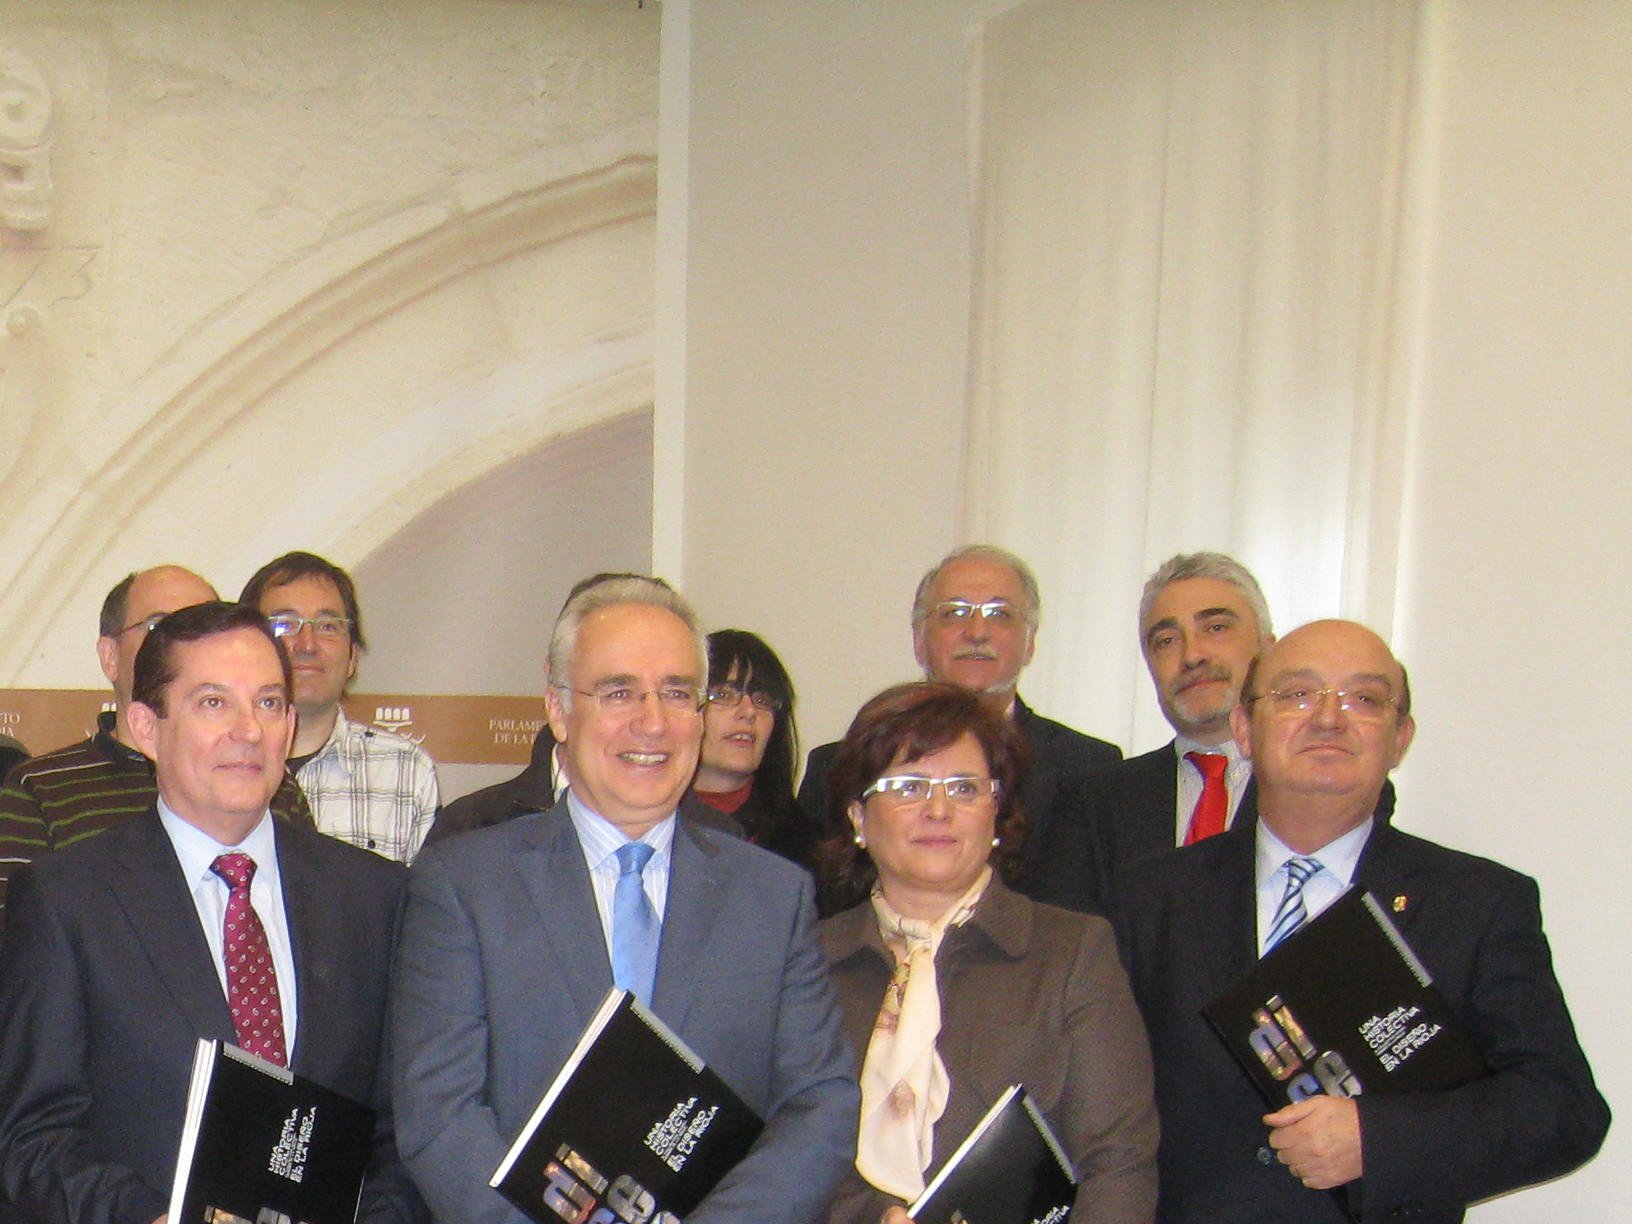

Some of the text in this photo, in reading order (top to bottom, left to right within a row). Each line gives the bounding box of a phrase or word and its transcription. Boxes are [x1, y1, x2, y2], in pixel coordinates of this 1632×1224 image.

[489, 719, 544, 731] PARLAME
[1358, 1015, 1381, 1034] UNA
[1363, 1006, 1407, 1042] HISTORIA
[1369, 1006, 1421, 1049] COLECTIVA
[1379, 1053, 1394, 1065] EL
[1384, 1056, 1401, 1072] EN
[1399, 1047, 1414, 1061] LA
[1412, 1024, 1442, 1049] RIOJA
